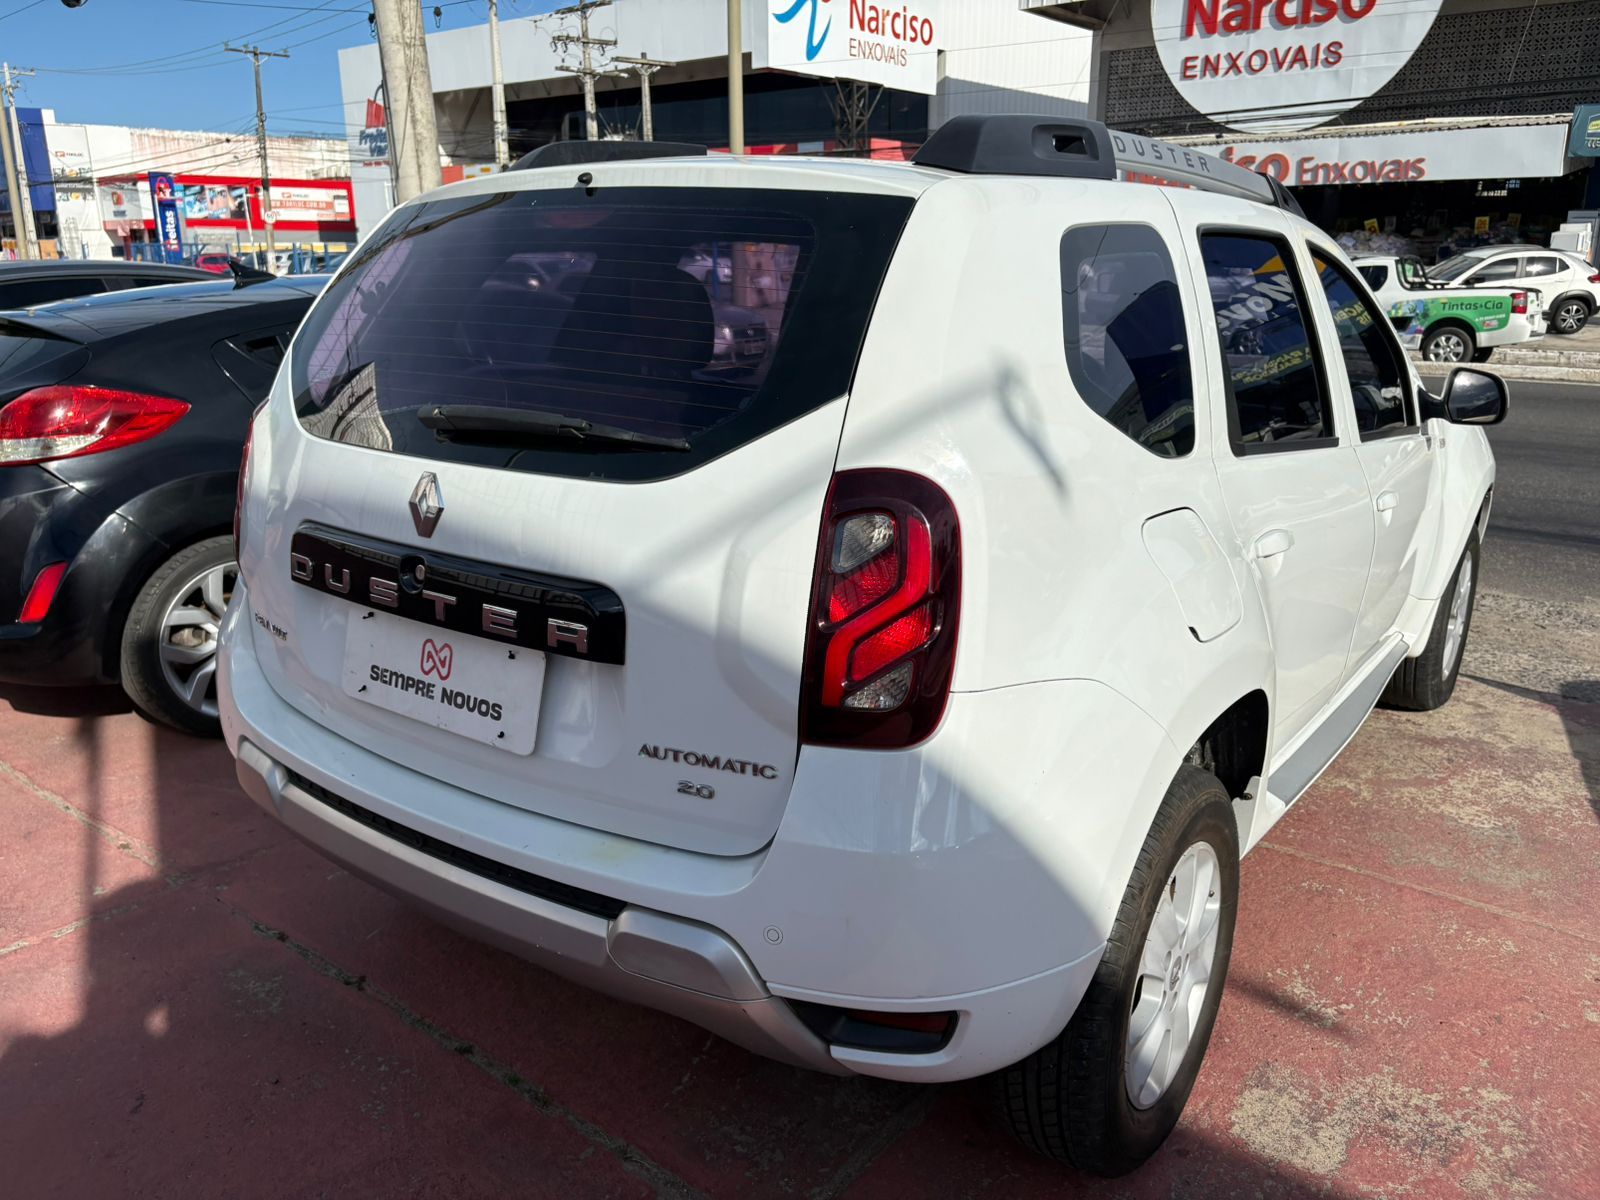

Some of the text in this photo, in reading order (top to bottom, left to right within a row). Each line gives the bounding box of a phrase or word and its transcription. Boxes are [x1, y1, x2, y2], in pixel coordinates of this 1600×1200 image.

[849, 0, 933, 46] Narciso
[1185, 0, 1377, 38] Narciso
[849, 38, 908, 67] ENXOVAIS
[1182, 41, 1344, 81] ENXOVAIS
[1112, 135, 1211, 174] DUSTER
[1300, 156, 1426, 184] Enxovais
[291, 552, 588, 653] DUSTER
[370, 664, 503, 721] SEMPRE NOVOS
[638, 743, 778, 780] AUTOMATIC
